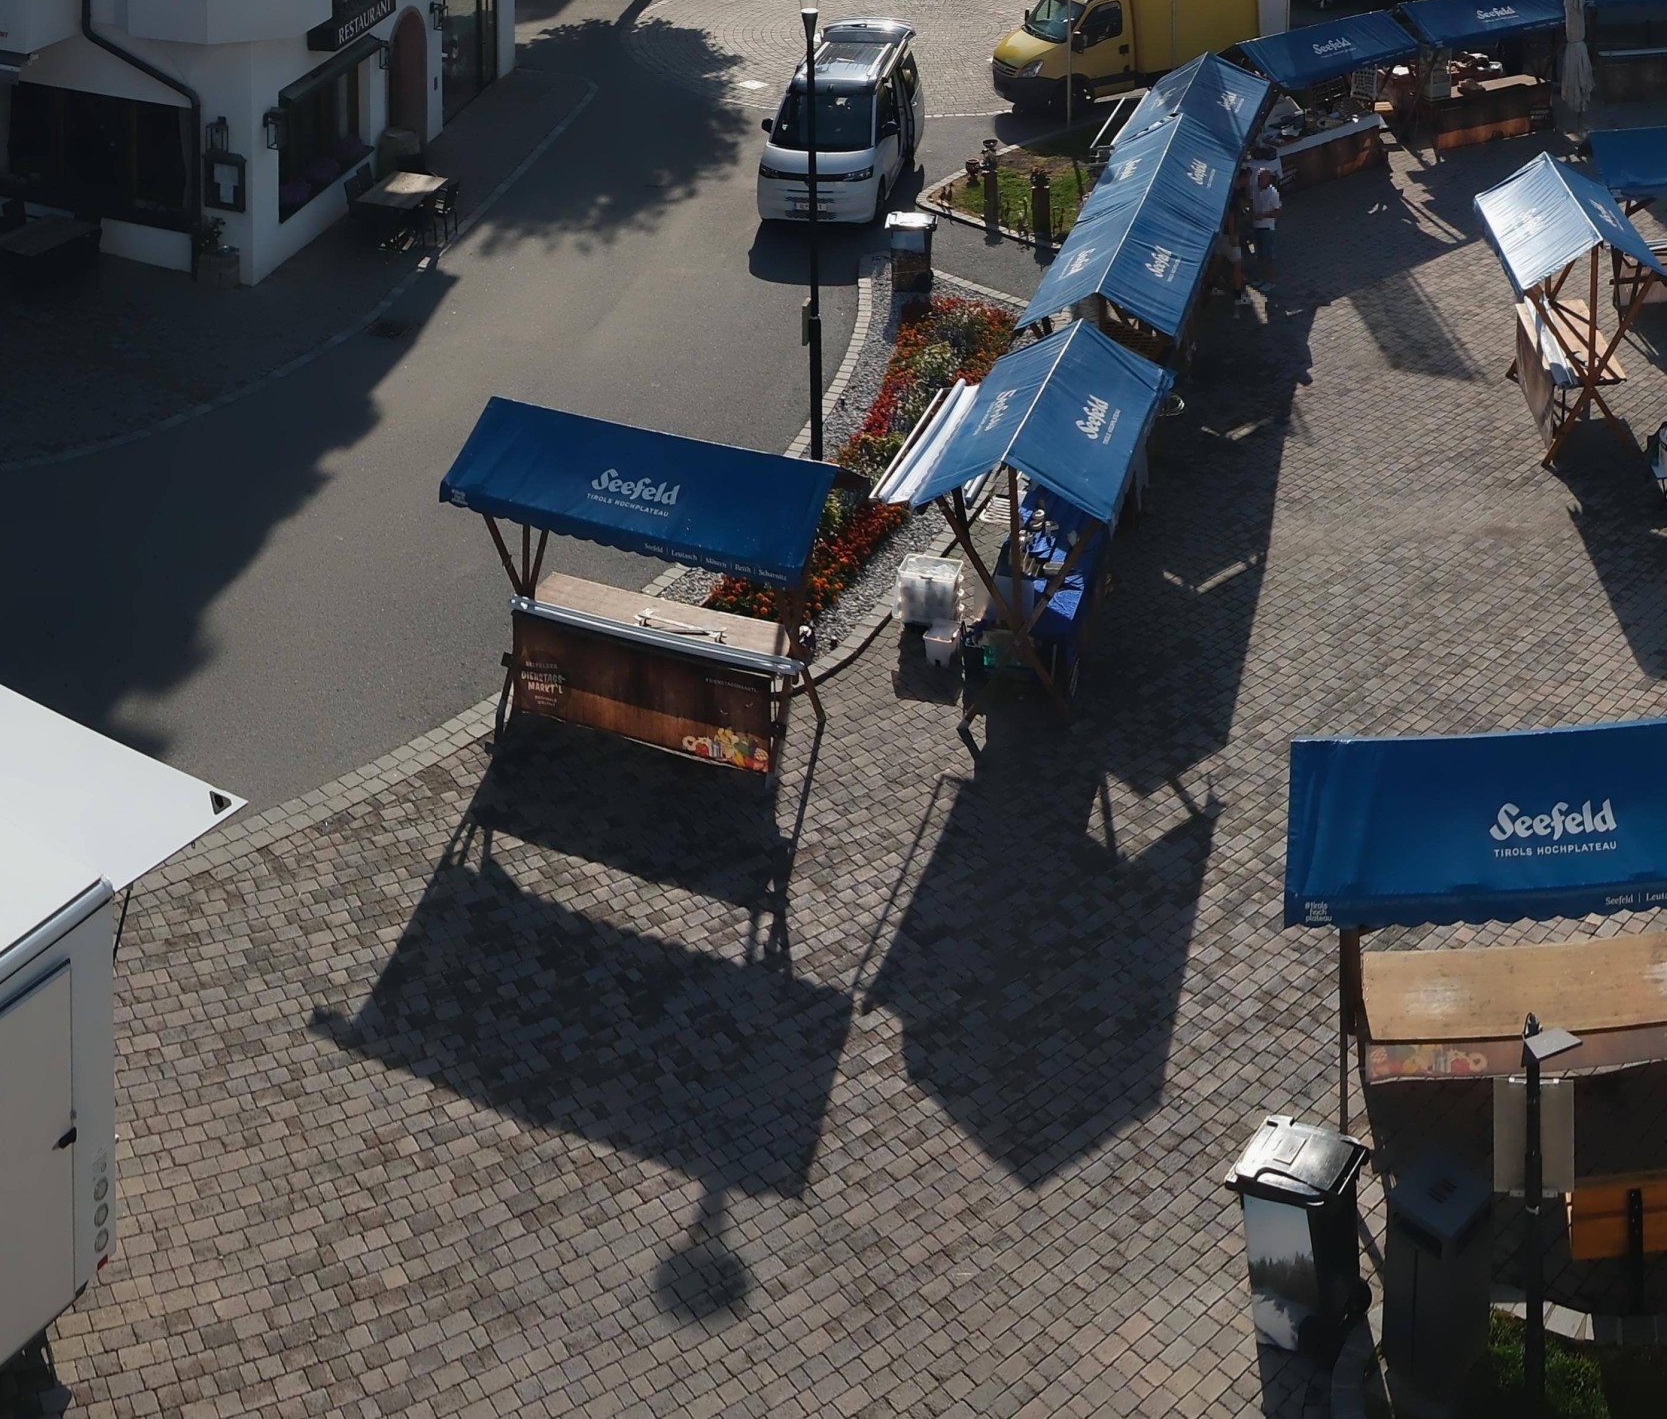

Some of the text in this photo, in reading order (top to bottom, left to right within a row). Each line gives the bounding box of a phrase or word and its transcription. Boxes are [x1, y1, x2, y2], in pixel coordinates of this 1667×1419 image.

[591, 468, 681, 506] Seefeld
[586, 493, 669, 518] TIROLS HOCHPLATEAU
[1489, 798, 1617, 841] Seefeld
[1493, 841, 1617, 858] TIROLS HOCHPLATEAU
[1605, 895, 1634, 906] Seefeld
